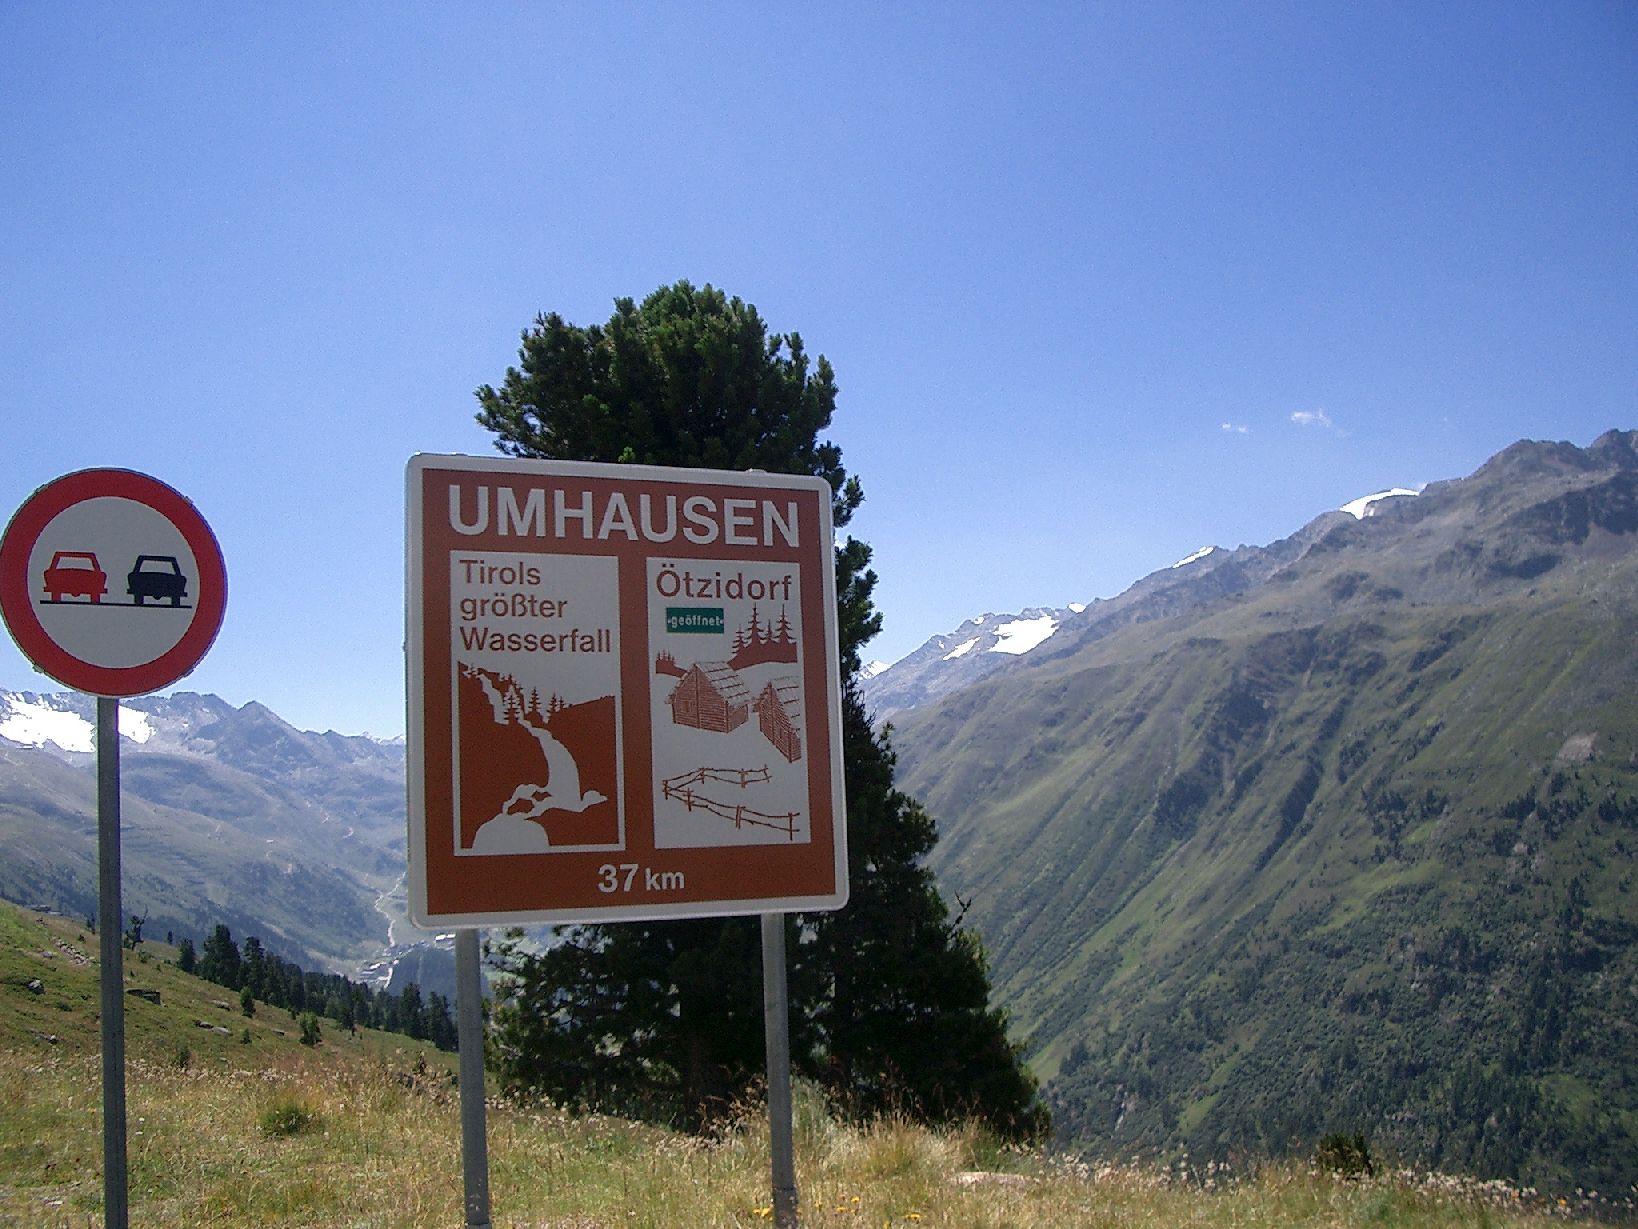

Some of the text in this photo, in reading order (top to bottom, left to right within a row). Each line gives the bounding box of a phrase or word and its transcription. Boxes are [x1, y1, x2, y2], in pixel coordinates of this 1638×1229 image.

[448, 484, 800, 548] UMHAUSEN
[459, 559, 541, 586] Tirols
[656, 563, 792, 601] Ötzidorf
[459, 594, 568, 621] größter
[459, 626, 611, 653] Wasserfall
[597, 863, 685, 893] 37 km
